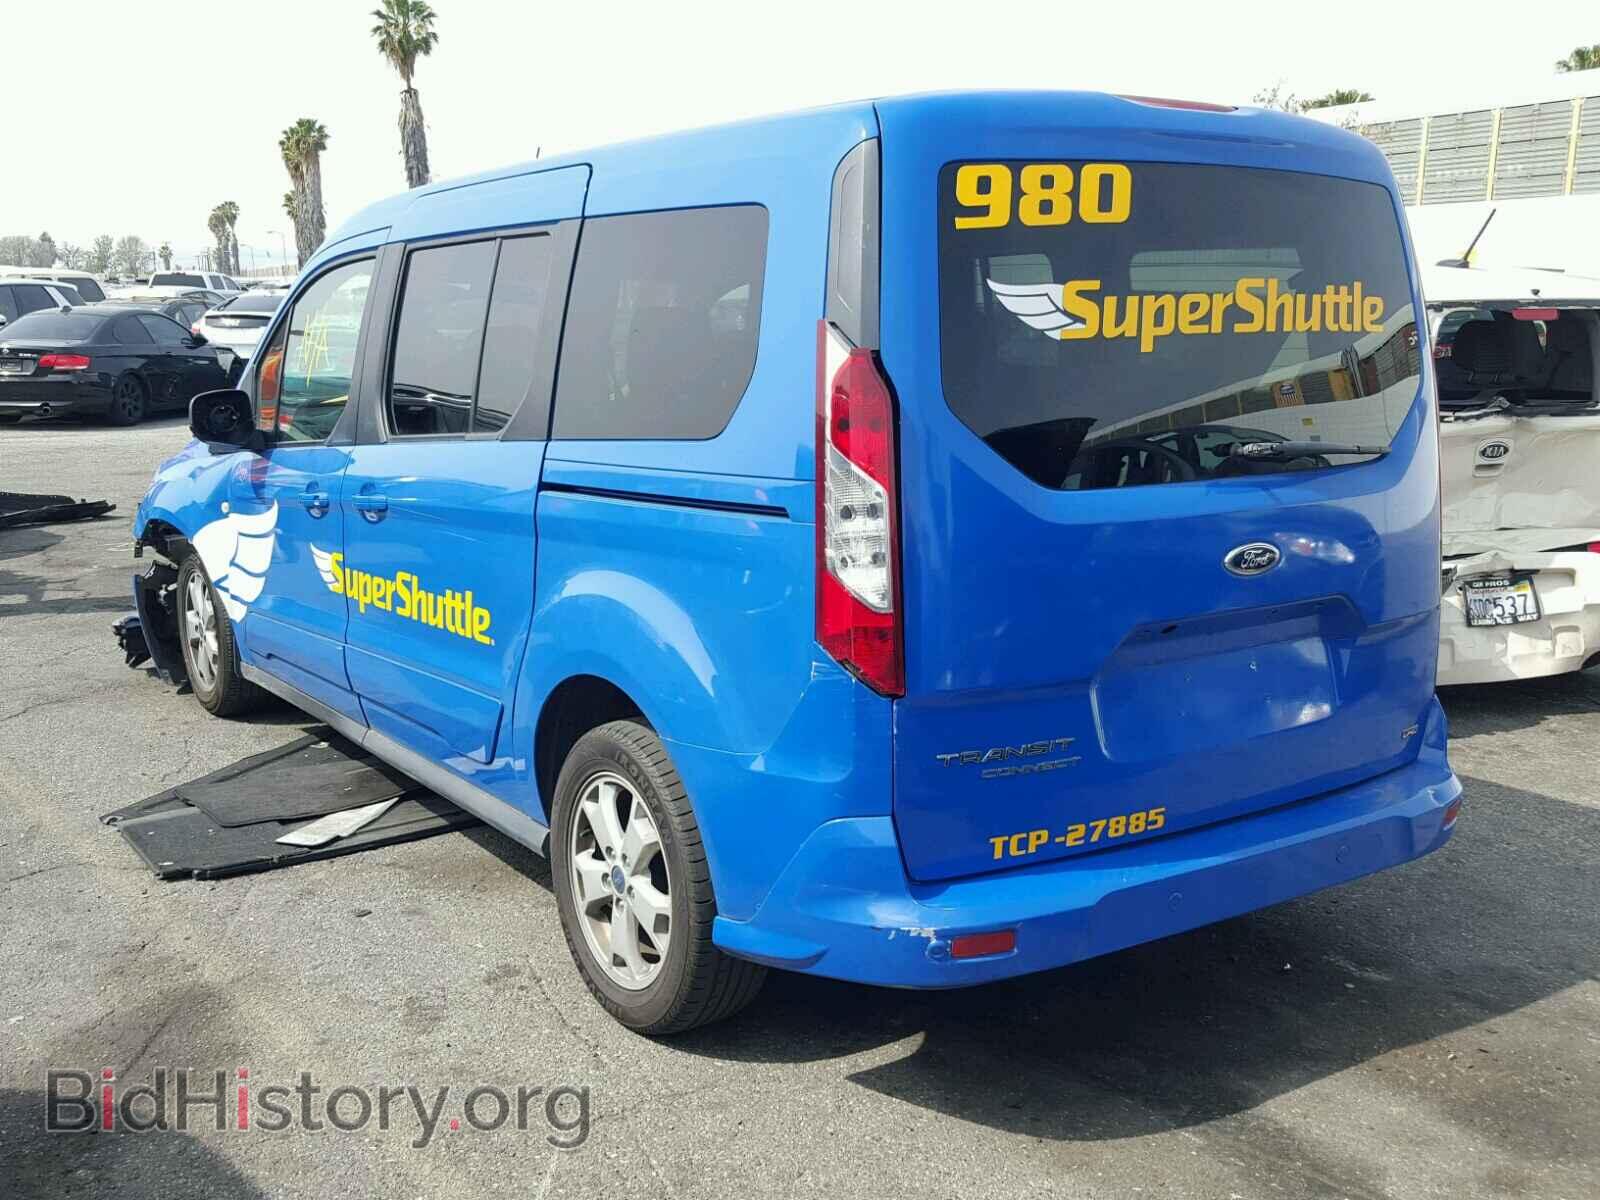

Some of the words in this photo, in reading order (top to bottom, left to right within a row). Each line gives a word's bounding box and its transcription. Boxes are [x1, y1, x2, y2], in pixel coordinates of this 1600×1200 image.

[955, 163, 1133, 230] 980
[1060, 277, 1385, 353] SuperShuttle
[1240, 549, 1275, 569] Ford
[935, 736, 1076, 768] TRANSIT
